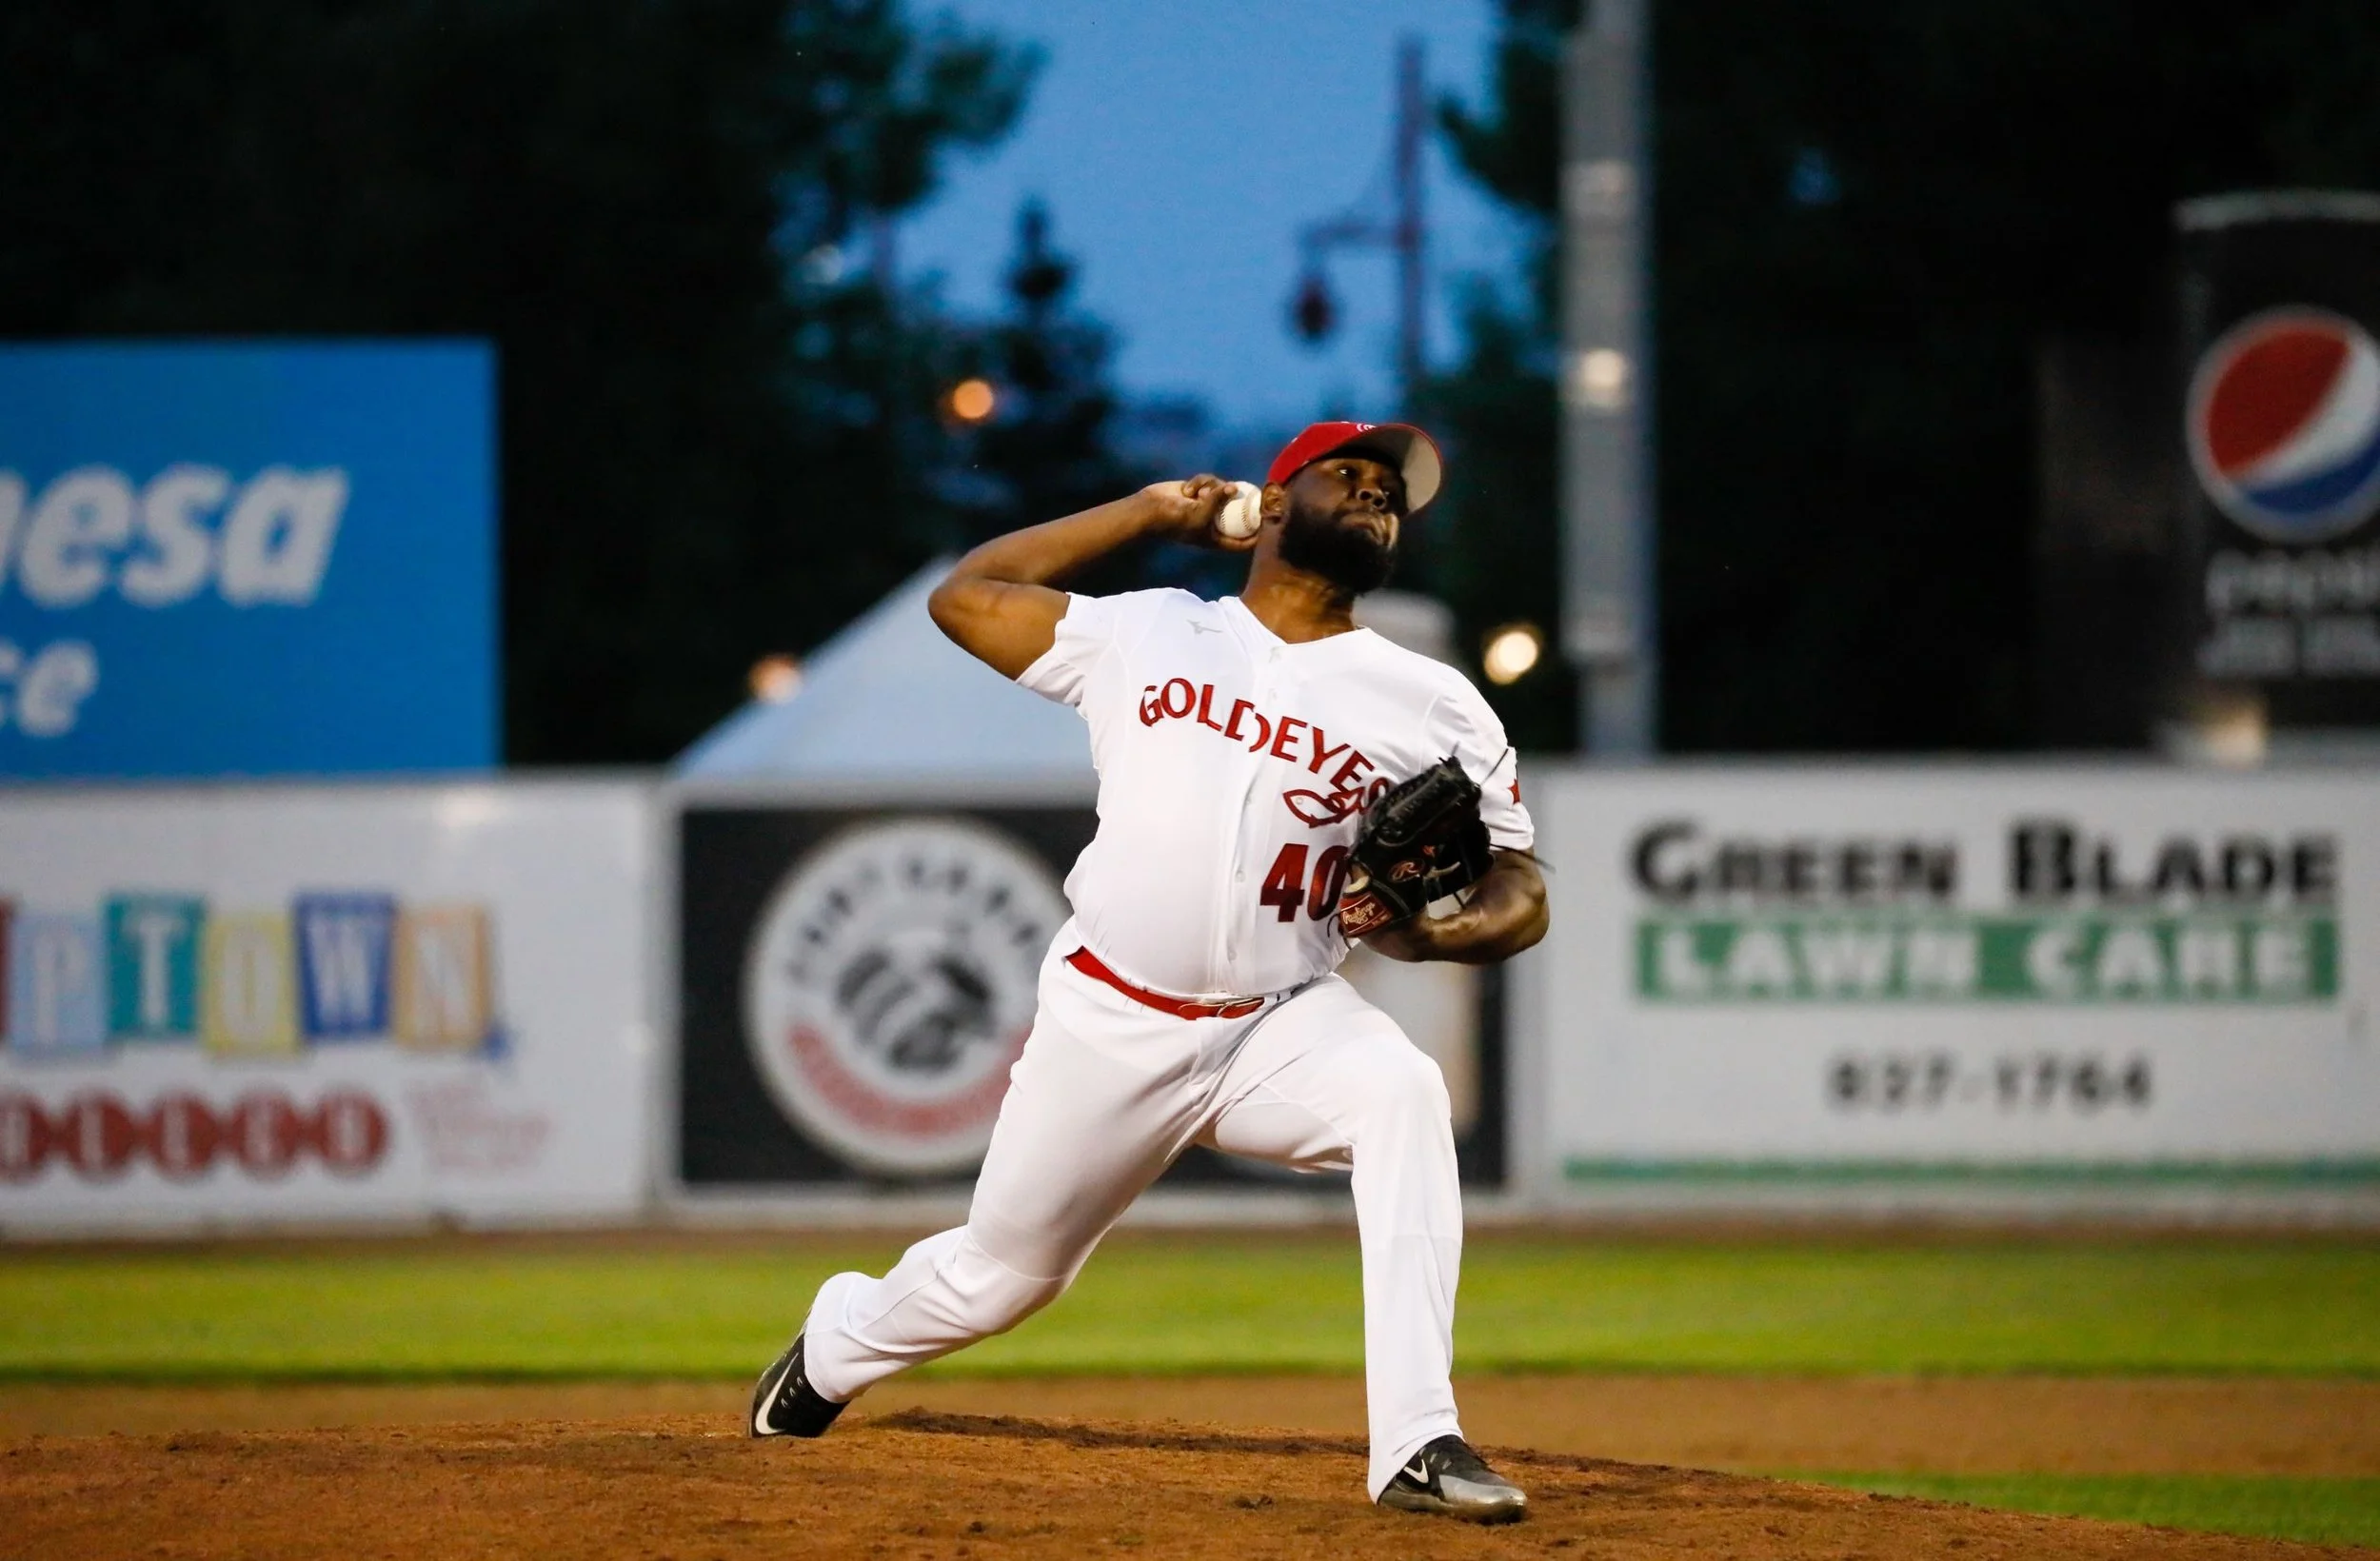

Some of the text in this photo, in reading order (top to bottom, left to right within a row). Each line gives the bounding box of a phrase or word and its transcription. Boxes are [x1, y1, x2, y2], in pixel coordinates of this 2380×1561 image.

[1259, 842, 1350, 922] 40
[2009, 820, 2337, 899] BLADE
[32, 909, 478, 1050] PTOWN
[1654, 919, 2311, 998] LAWN CARE
